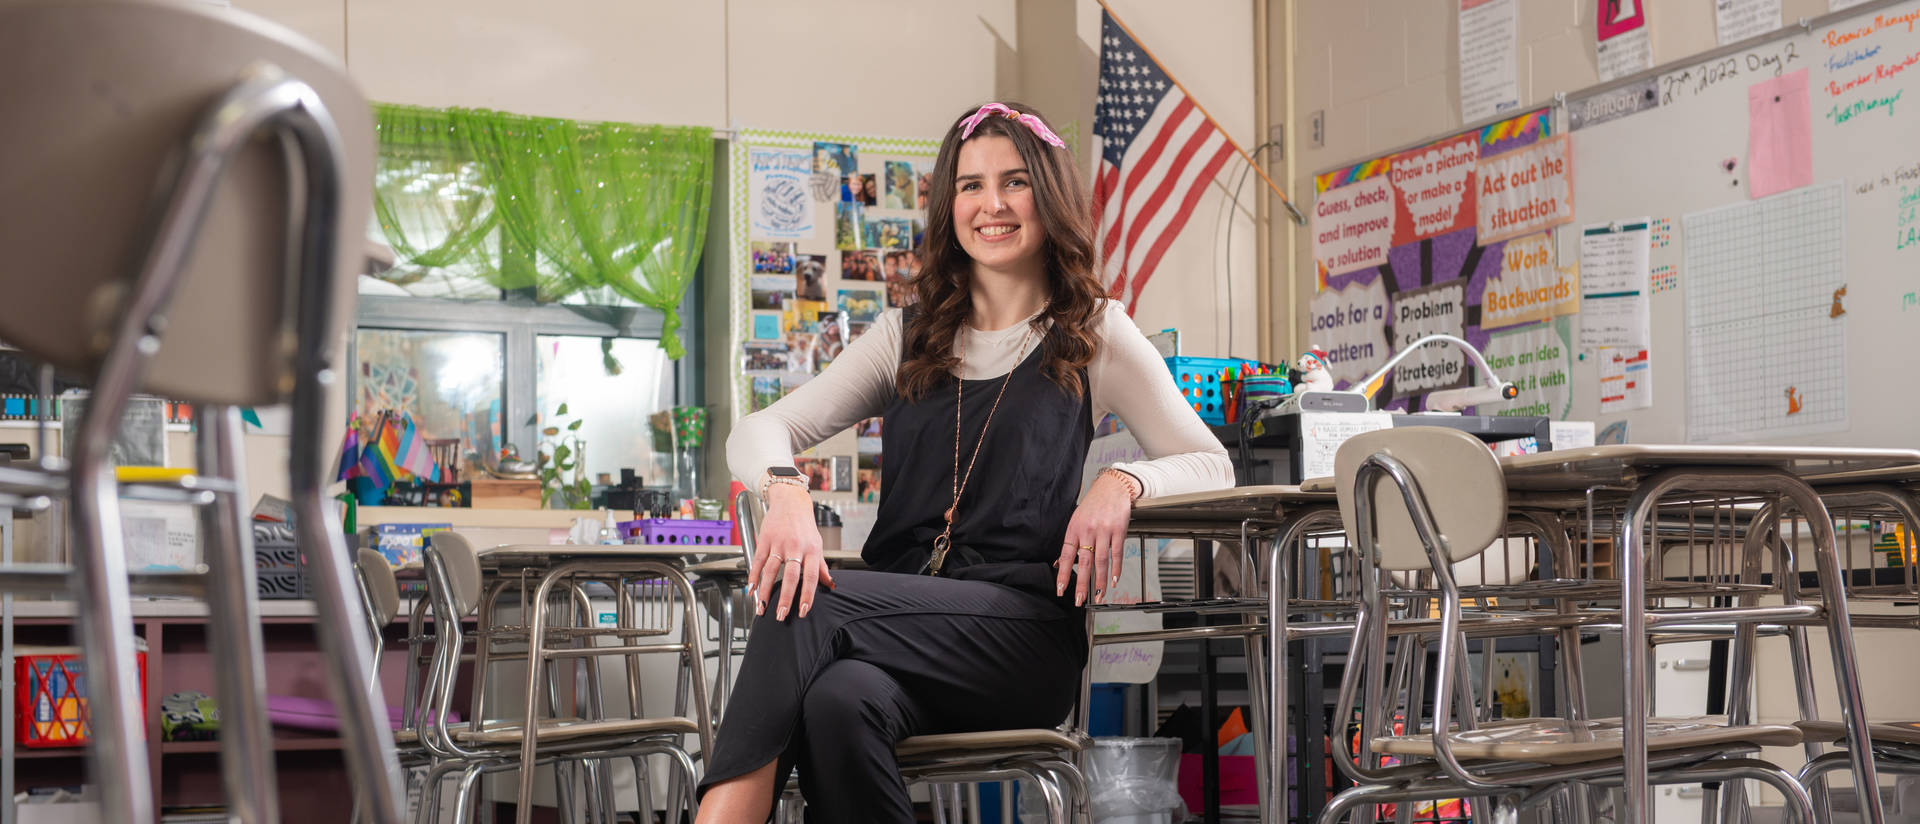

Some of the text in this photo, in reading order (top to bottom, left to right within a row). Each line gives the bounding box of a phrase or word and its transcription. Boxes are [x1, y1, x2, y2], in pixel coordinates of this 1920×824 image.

[1746, 53, 1783, 77] Day
[1785, 41, 1801, 63] 2
[1584, 92, 1641, 121] January
[1395, 150, 1474, 183] Draw a picture
[1482, 155, 1563, 197] Act out the
[1317, 186, 1390, 218] Guess, check,
[1407, 182, 1463, 205] or make a
[1419, 205, 1452, 228] model
[1491, 197, 1557, 230] situation
[1319, 217, 1389, 245] and improve
[1328, 245, 1381, 268] a solution
[1508, 246, 1548, 272] Work
[1488, 280, 1569, 313] Backwards
[1310, 303, 1383, 332] Look for a
[1401, 300, 1453, 323] Problem
[1328, 342, 1374, 364] attern
[1485, 344, 1560, 370] Have an idea
[1397, 359, 1459, 383] Strategies
[1529, 374, 1537, 390] it
[1540, 368, 1566, 389] with
